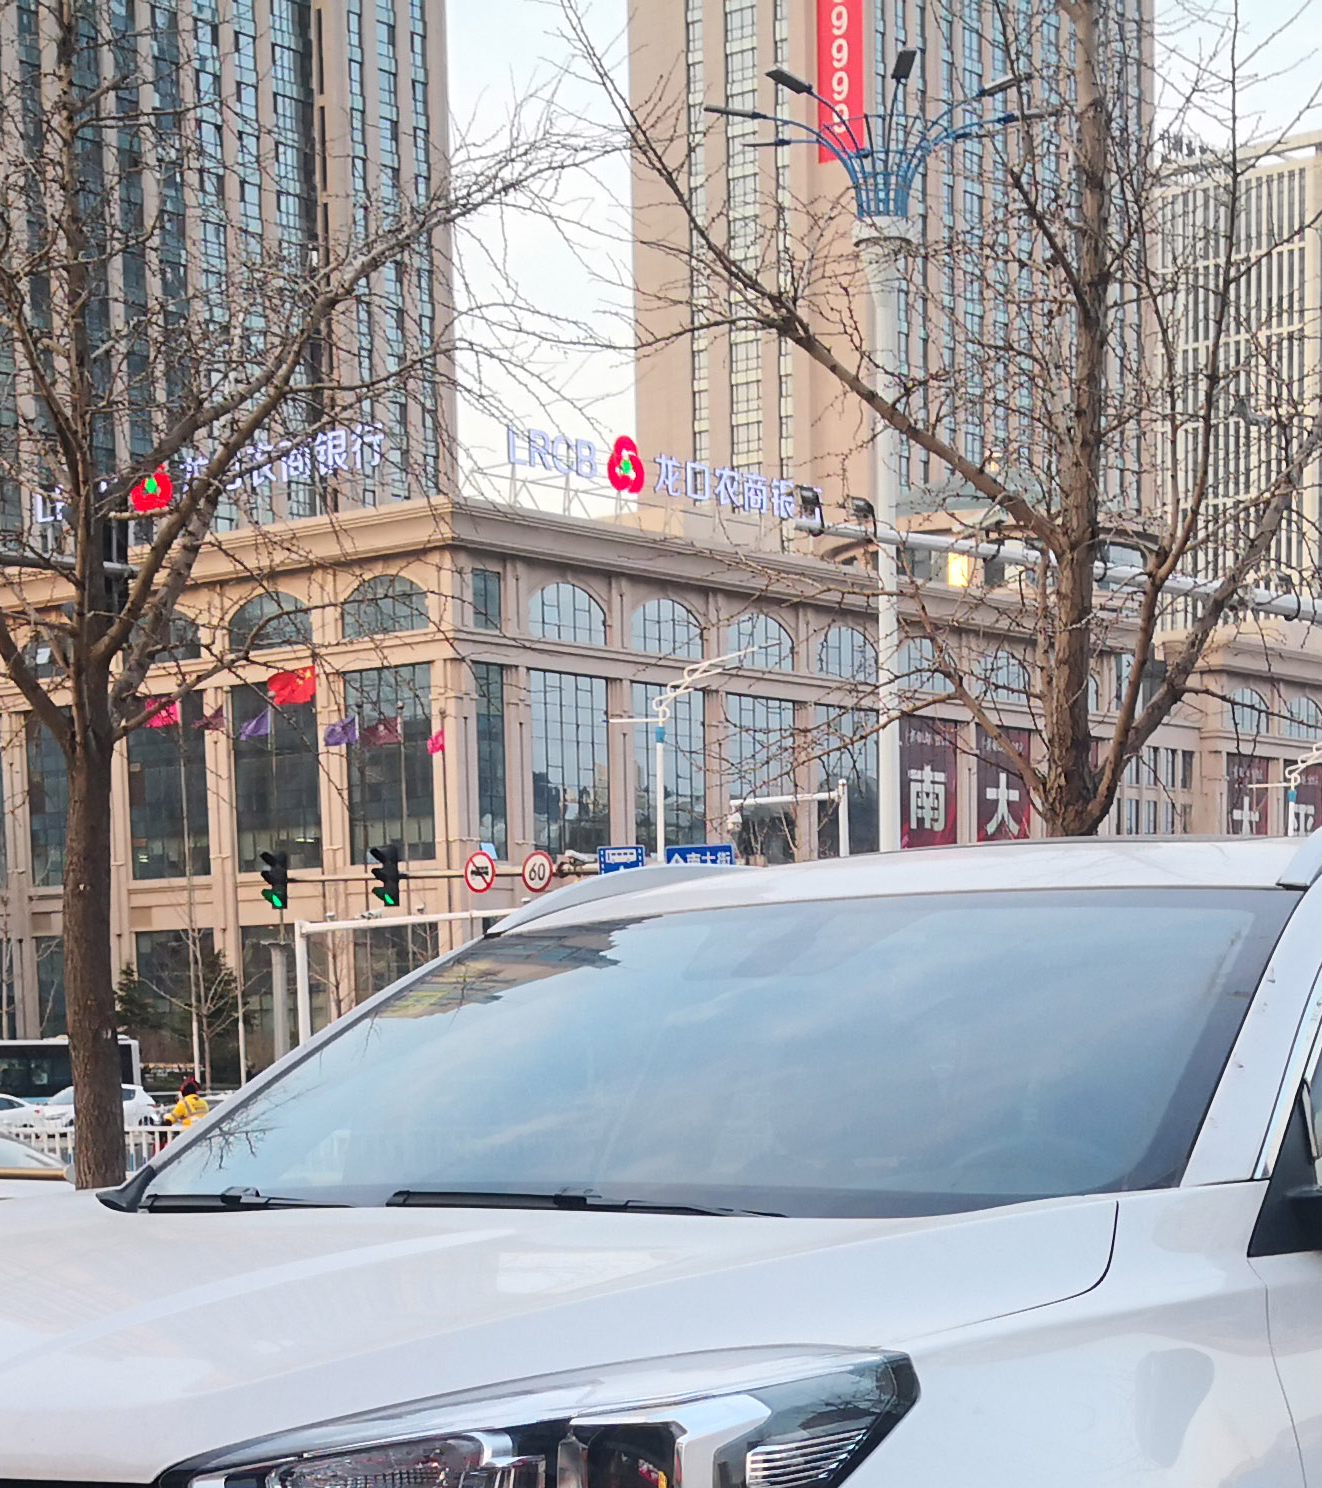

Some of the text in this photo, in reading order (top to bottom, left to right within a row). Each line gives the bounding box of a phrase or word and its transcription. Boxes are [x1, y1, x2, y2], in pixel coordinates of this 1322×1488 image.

[830, 0, 850, 134] 9999
[180, 422, 385, 492] 农商银行
[506, 424, 597, 480] LRCB
[653, 452, 824, 520] 龙口农商银
[528, 862, 546, 881] 60
